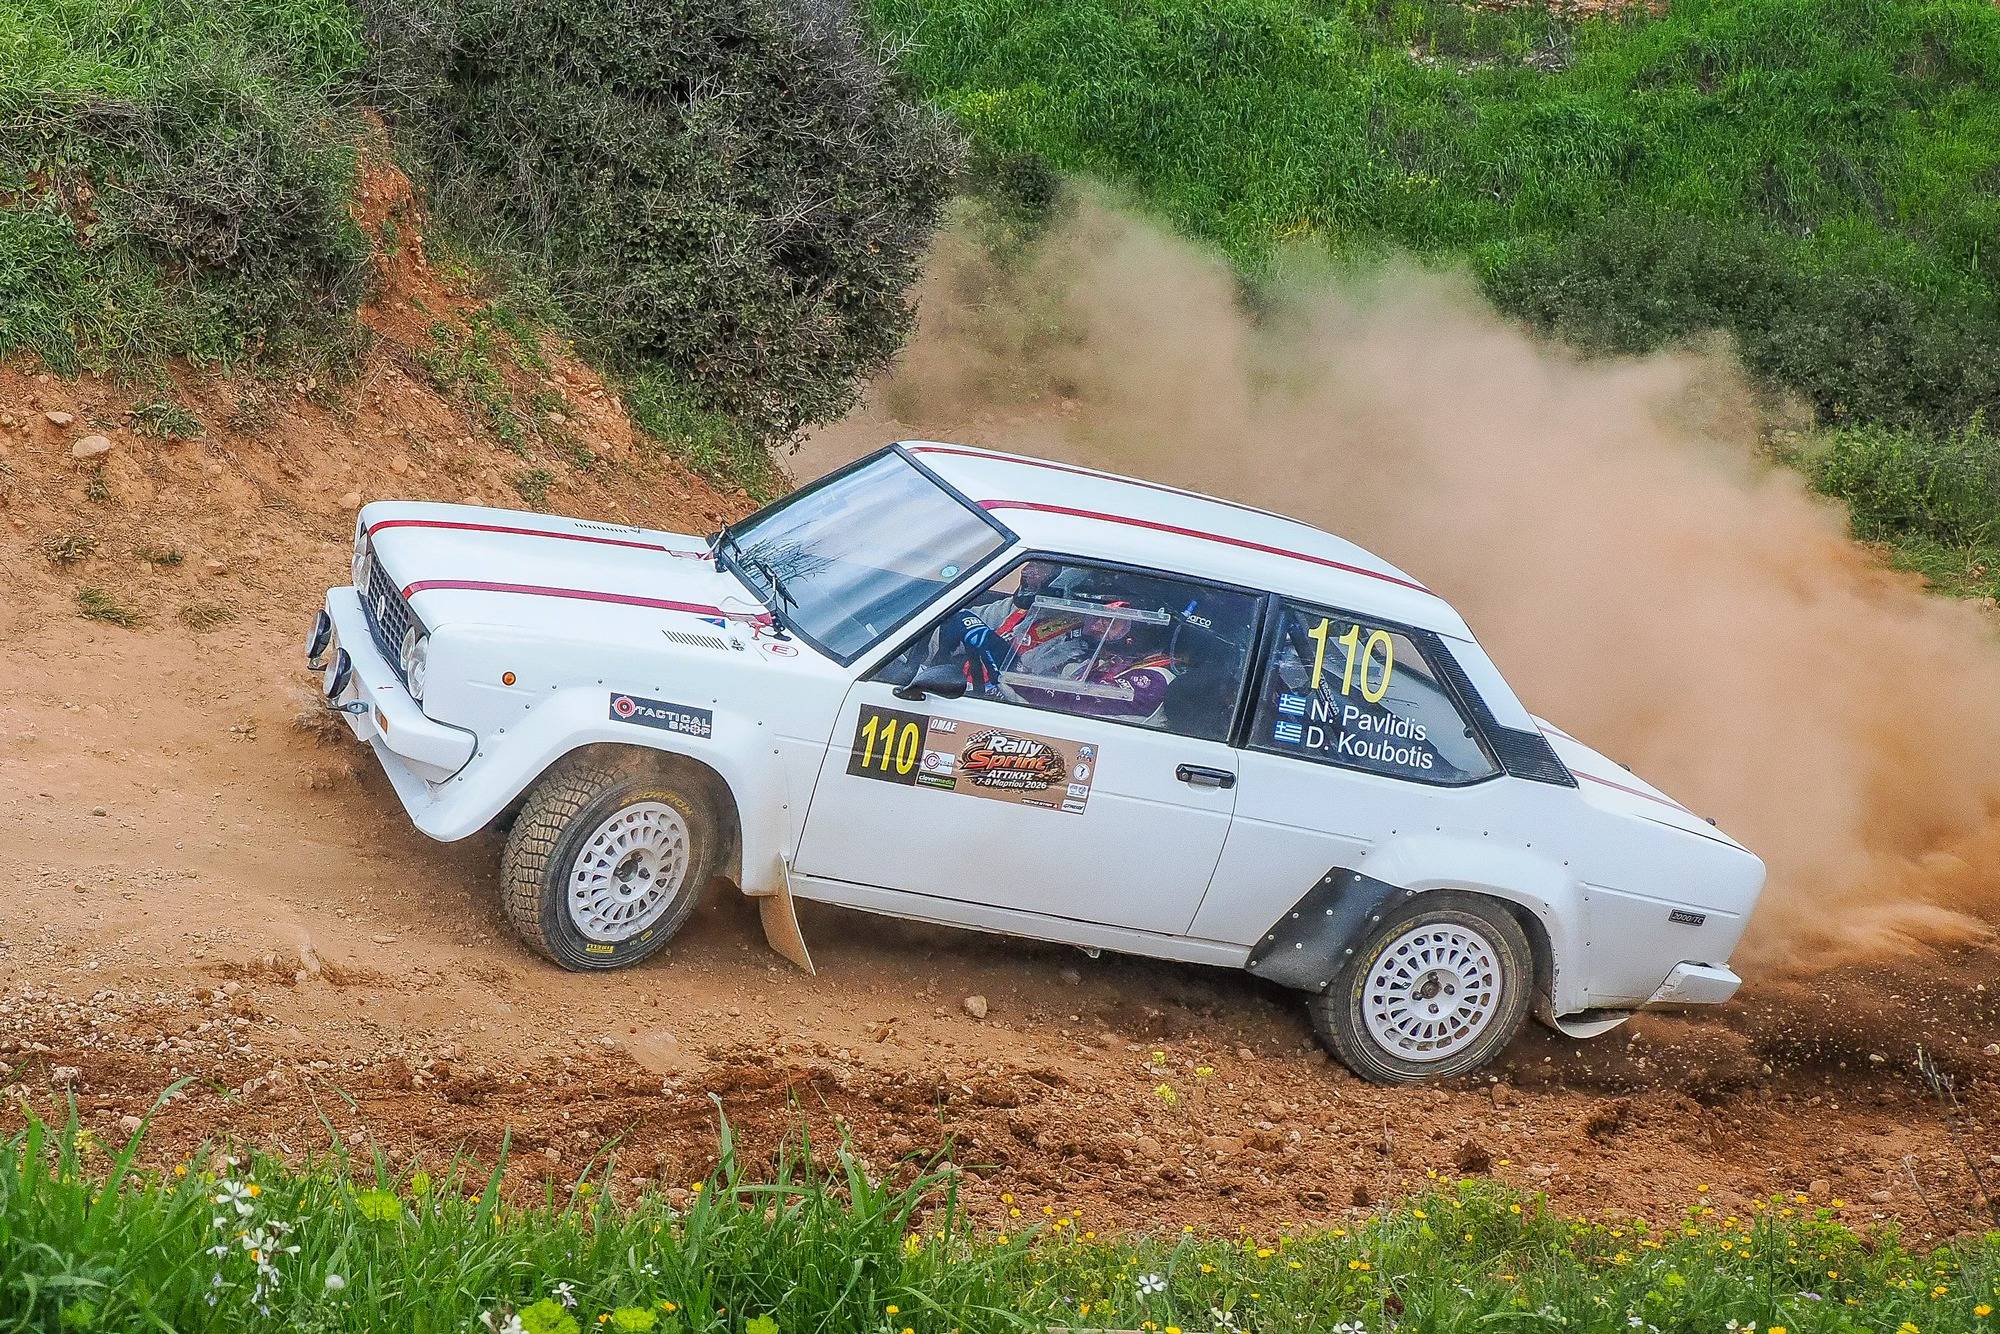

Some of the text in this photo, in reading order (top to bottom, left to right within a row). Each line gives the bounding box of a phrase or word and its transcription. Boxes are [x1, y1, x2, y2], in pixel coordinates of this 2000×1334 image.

[1307, 617, 1394, 704] 110
[636, 705, 711, 727] TACTICAL
[1310, 698, 1427, 741] N. Pavlidis
[669, 721, 711, 735] SHOP
[861, 715, 919, 775] 110
[987, 735, 1043, 757] Rally
[1305, 725, 1433, 769] D. Koubotis
[960, 749, 1051, 770] Sprint
[976, 777, 991, 786] 7-8
[1024, 781, 1048, 789] 2026
[987, 769, 1035, 781] ΑΤΤΙΚΗΣ
